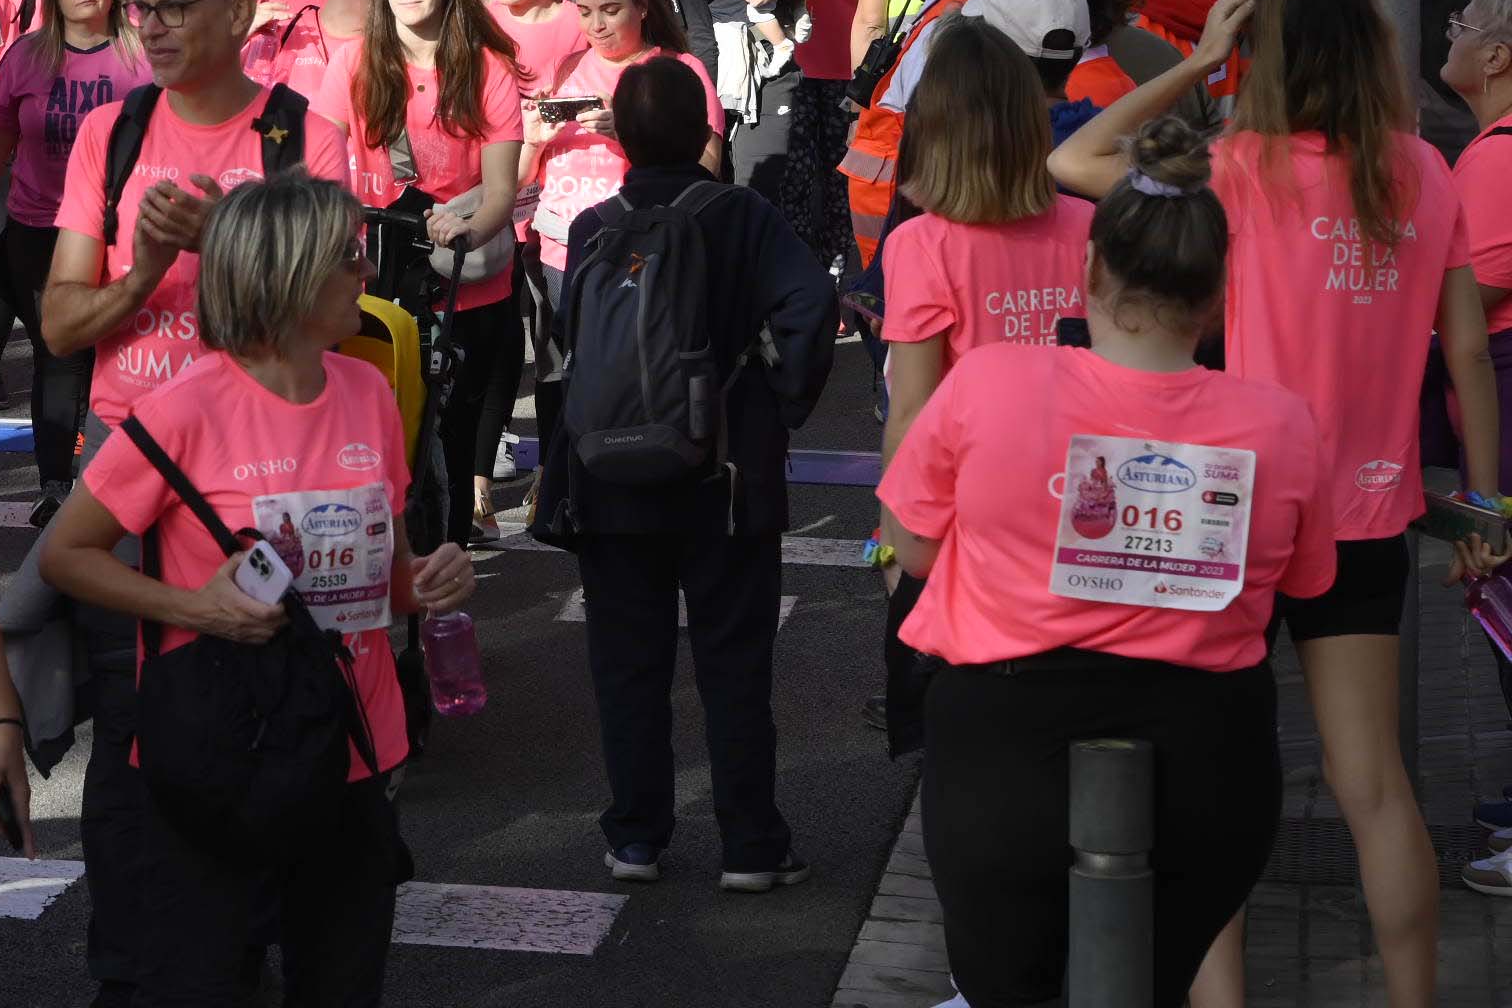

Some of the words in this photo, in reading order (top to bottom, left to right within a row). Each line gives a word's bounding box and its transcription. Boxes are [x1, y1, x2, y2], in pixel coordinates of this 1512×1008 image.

[1333, 243, 1362, 266] DE
[1370, 244, 1398, 266] LA
[985, 287, 1083, 315] CARRERA
[135, 309, 200, 341] ORS
[1004, 315, 1036, 338] DE
[233, 456, 297, 481] OYSHO
[1122, 467, 1190, 486] ASTURIANA
[1202, 470, 1240, 481] SUMA
[306, 517, 358, 531] ASTURIANA
[1121, 505, 1184, 533] 016
[1124, 535, 1174, 554] 27213
[308, 547, 355, 570] 016
[1076, 553, 1127, 567] CARRERA
[1126, 558, 1143, 568] DE
[1143, 559, 1158, 570] LA
[1159, 561, 1197, 574] MUJER
[1067, 574, 1124, 592] OYSHO
[1168, 585, 1226, 600] Santander
